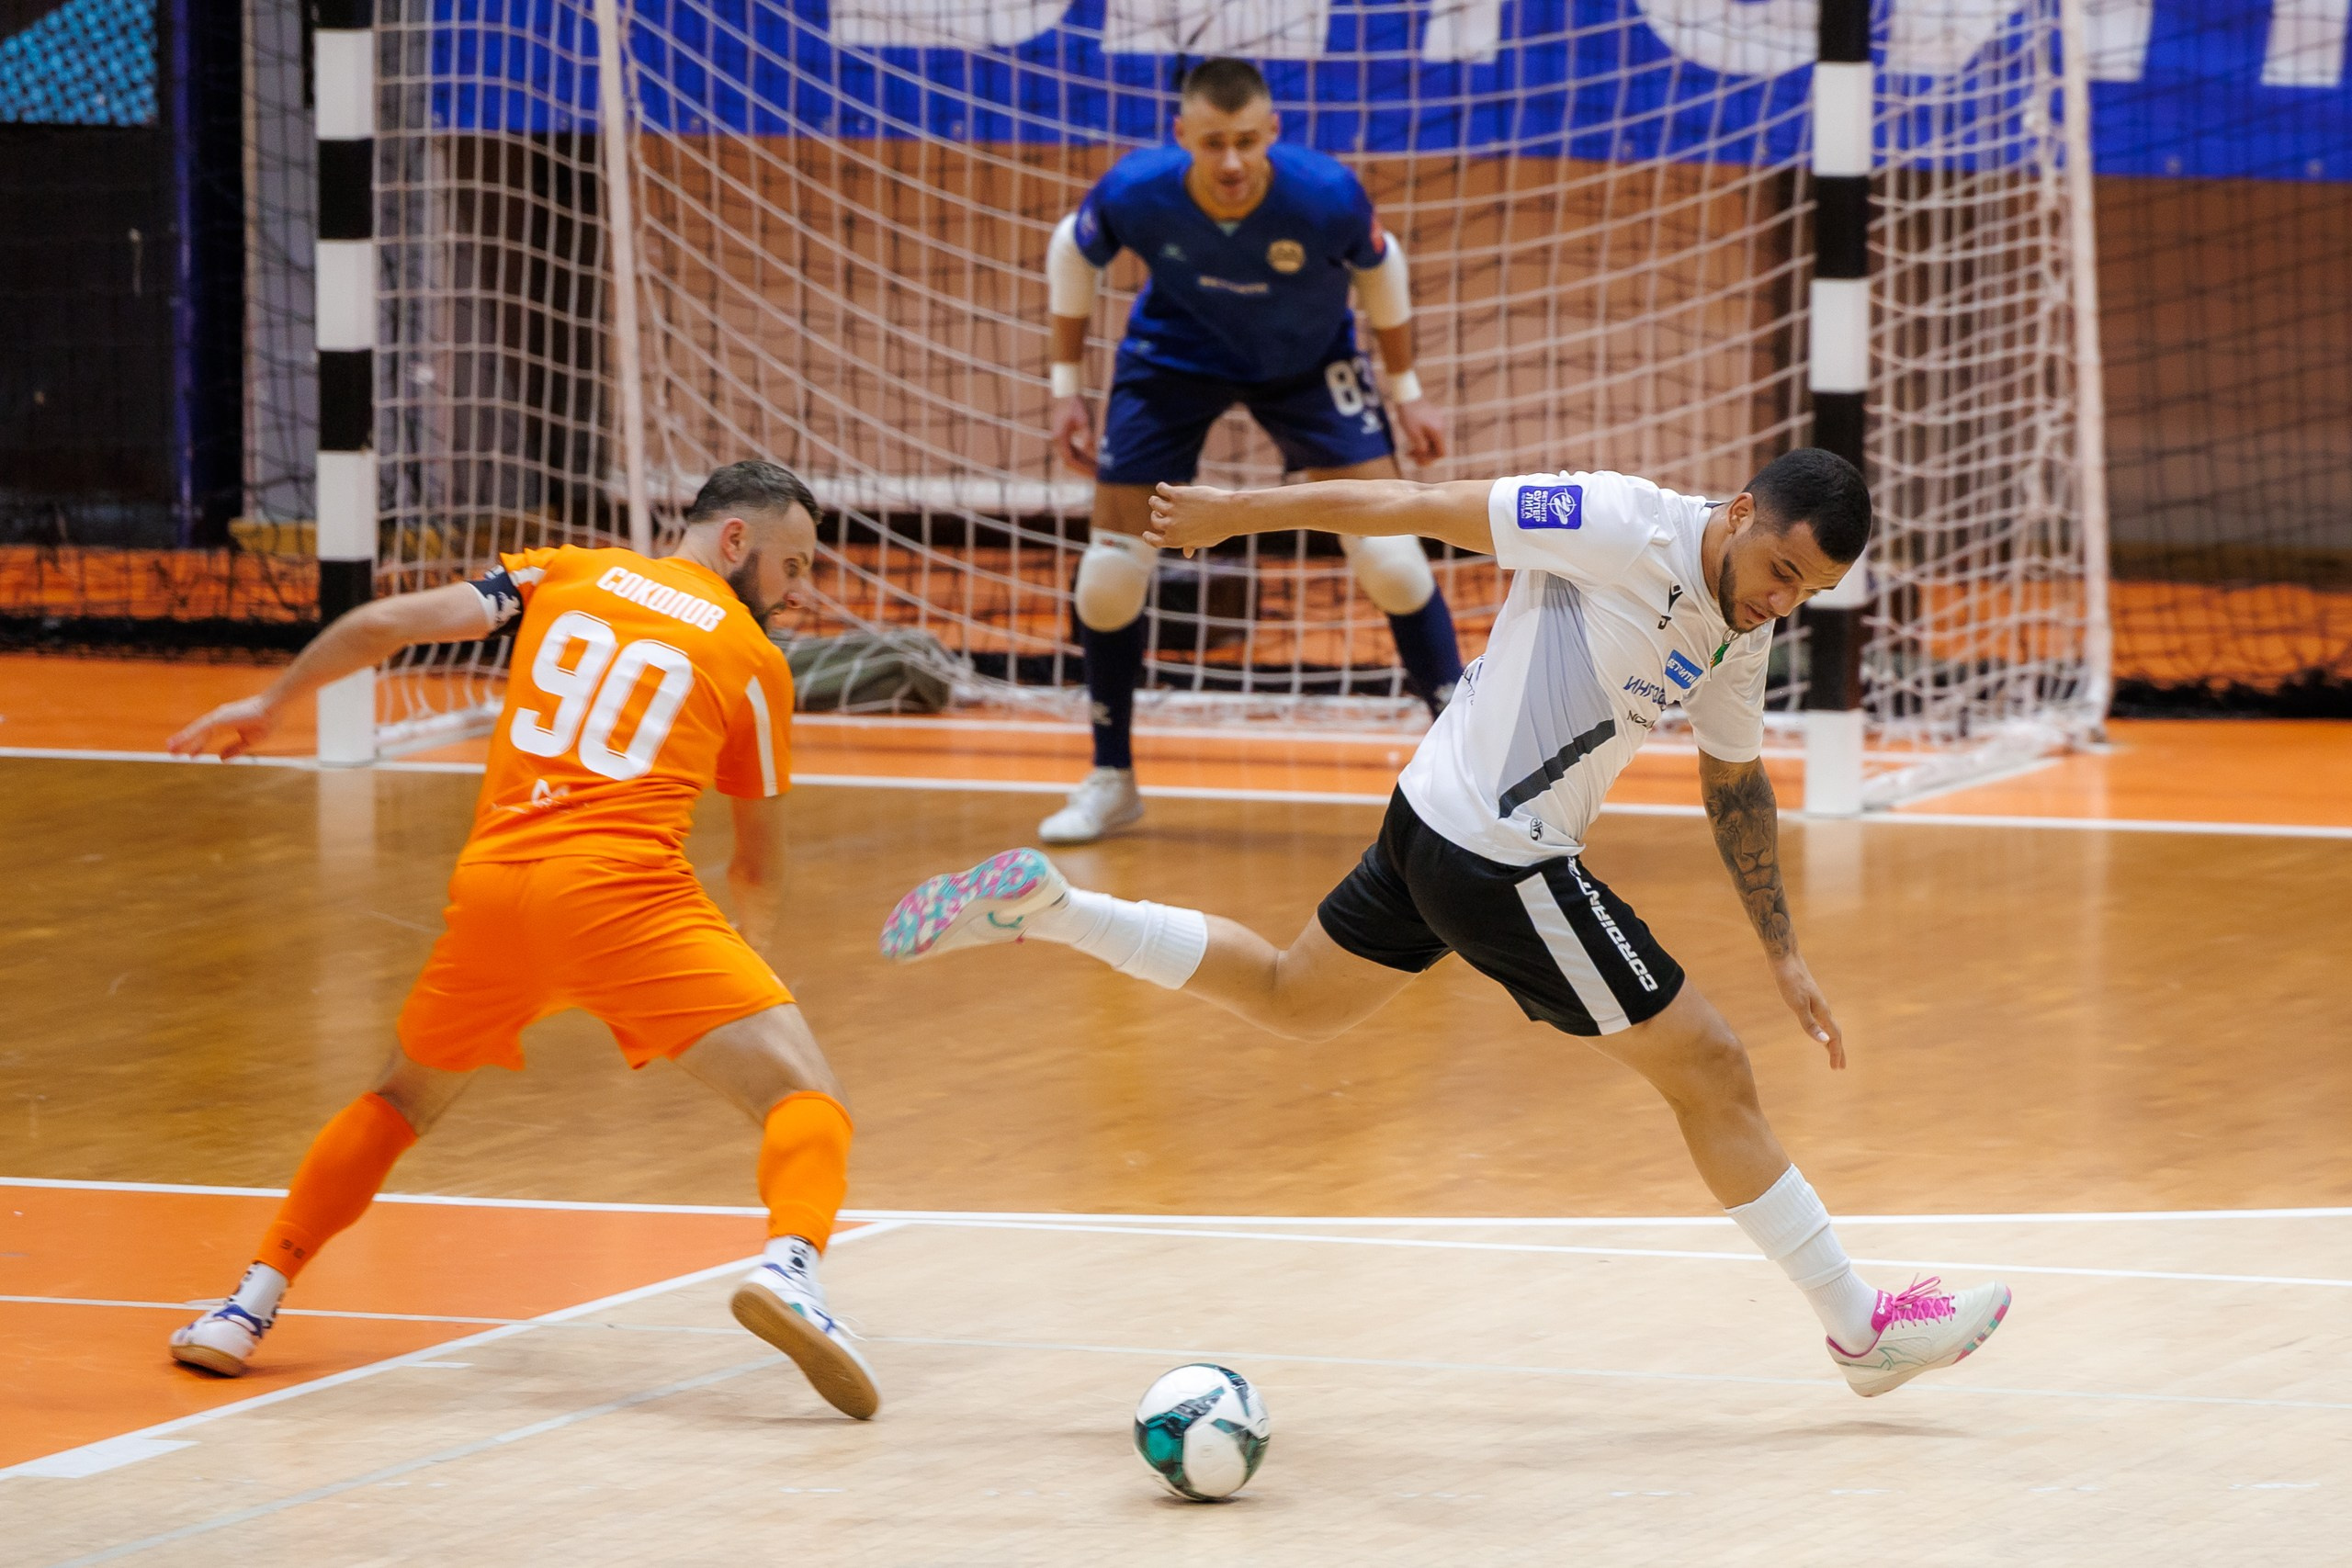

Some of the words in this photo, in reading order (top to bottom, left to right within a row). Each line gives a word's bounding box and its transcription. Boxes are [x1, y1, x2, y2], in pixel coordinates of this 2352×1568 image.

[1524, 491, 1534, 519] ЛИГА
[1532, 490, 1542, 522] СУПЕР
[596, 566, 727, 632] СОКОЛОВ
[510, 610, 695, 781] 90
